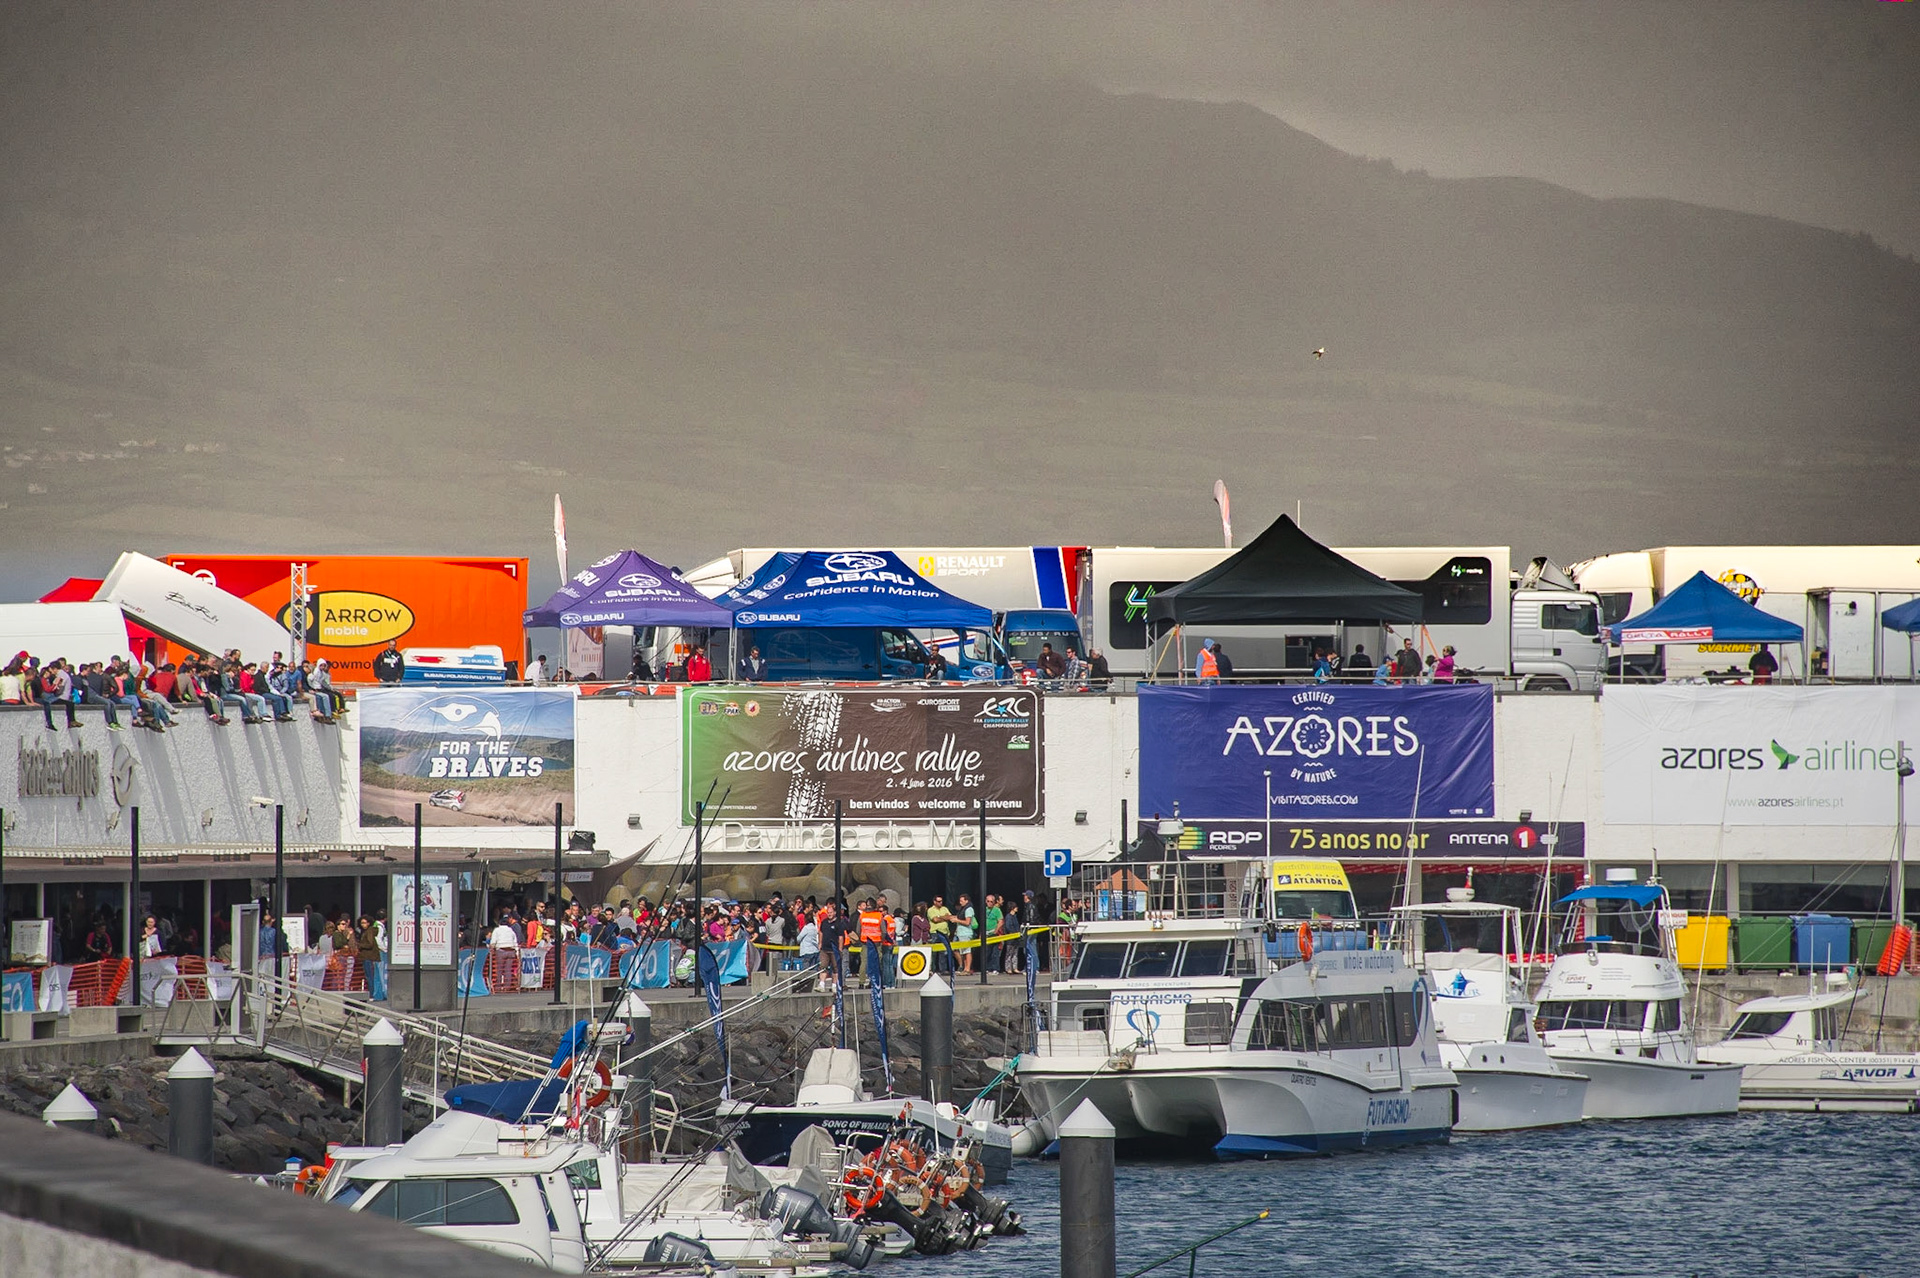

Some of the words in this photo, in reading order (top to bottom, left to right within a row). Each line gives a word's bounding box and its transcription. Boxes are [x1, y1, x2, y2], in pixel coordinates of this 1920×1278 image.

[937, 556, 1005, 568] RENAULT
[937, 568, 989, 576] SPORT
[805, 571, 915, 587] SUBARU
[604, 588, 681, 598] SUBARU
[783, 586, 869, 600] Confidence
[872, 585, 886, 593] in
[889, 586, 940, 598] Motion
[325, 609, 402, 623] ARROW
[582, 613, 625, 622] SUBARU
[323, 626, 369, 636] mobile
[1670, 630, 1710, 638] RALLY
[1292, 692, 1335, 705] CERTIFIED
[1223, 714, 1419, 759] AZORES
[438, 742, 471, 755] FOR
[475, 742, 510, 755] THE
[723, 750, 809, 775] azores
[816, 733, 907, 774] airlines
[915, 733, 983, 781] rallye
[1661, 747, 1763, 770] azores
[428, 756, 544, 778] BRAVES
[927, 777, 953, 788] 2016
[963, 774, 985, 787] 51st
[1290, 768, 1303, 780] BY
[1304, 768, 1337, 783] NATURE
[850, 799, 873, 809] bem
[874, 799, 910, 809] vindos
[918, 799, 966, 809] welcome
[973, 799, 1022, 809] benvenu
[1270, 795, 1358, 805] VISITAZORES.COM
[1727, 797, 1844, 810] www.azoresairlines.pt
[873, 820, 914, 849] do
[929, 819, 978, 850] Ma
[1209, 831, 1263, 844] RDP
[1289, 828, 1315, 849] 75
[1319, 833, 1371, 849] anos
[1376, 833, 1402, 849] no
[1407, 833, 1430, 849] ar
[1449, 833, 1509, 845] ANTENA
[1518, 830, 1529, 848] 1
[1209, 843, 1237, 851] AÇORES
[1050, 851, 1066, 875] P
[426, 926, 446, 943] SUL
[1111, 993, 1192, 1005] FUTURISMO
[1842, 1068, 1898, 1078] ARVOR
[1366, 1098, 1411, 1126] FUTURISMO
[822, 1119, 848, 1128] SONG
[849, 1120, 862, 1129] OF
[861, 1122, 890, 1130] WHALES
